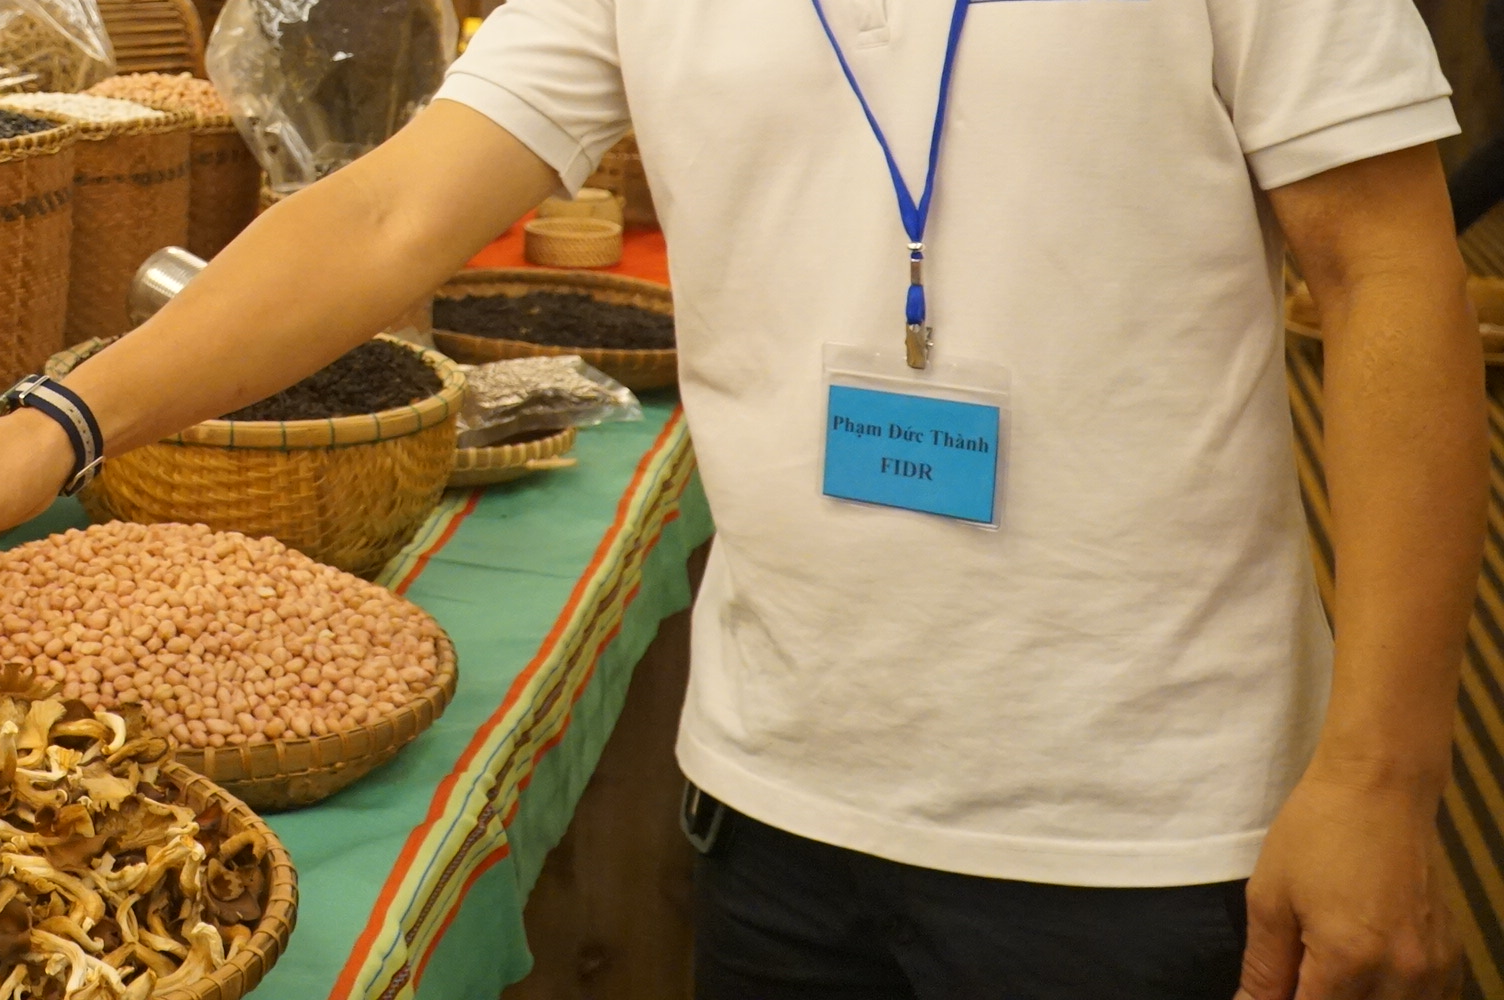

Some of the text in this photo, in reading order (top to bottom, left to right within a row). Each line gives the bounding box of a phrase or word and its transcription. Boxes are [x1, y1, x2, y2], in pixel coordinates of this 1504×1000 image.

[833, 415, 989, 453] Phạm Đức Thành
[881, 457, 933, 481] FIDR
